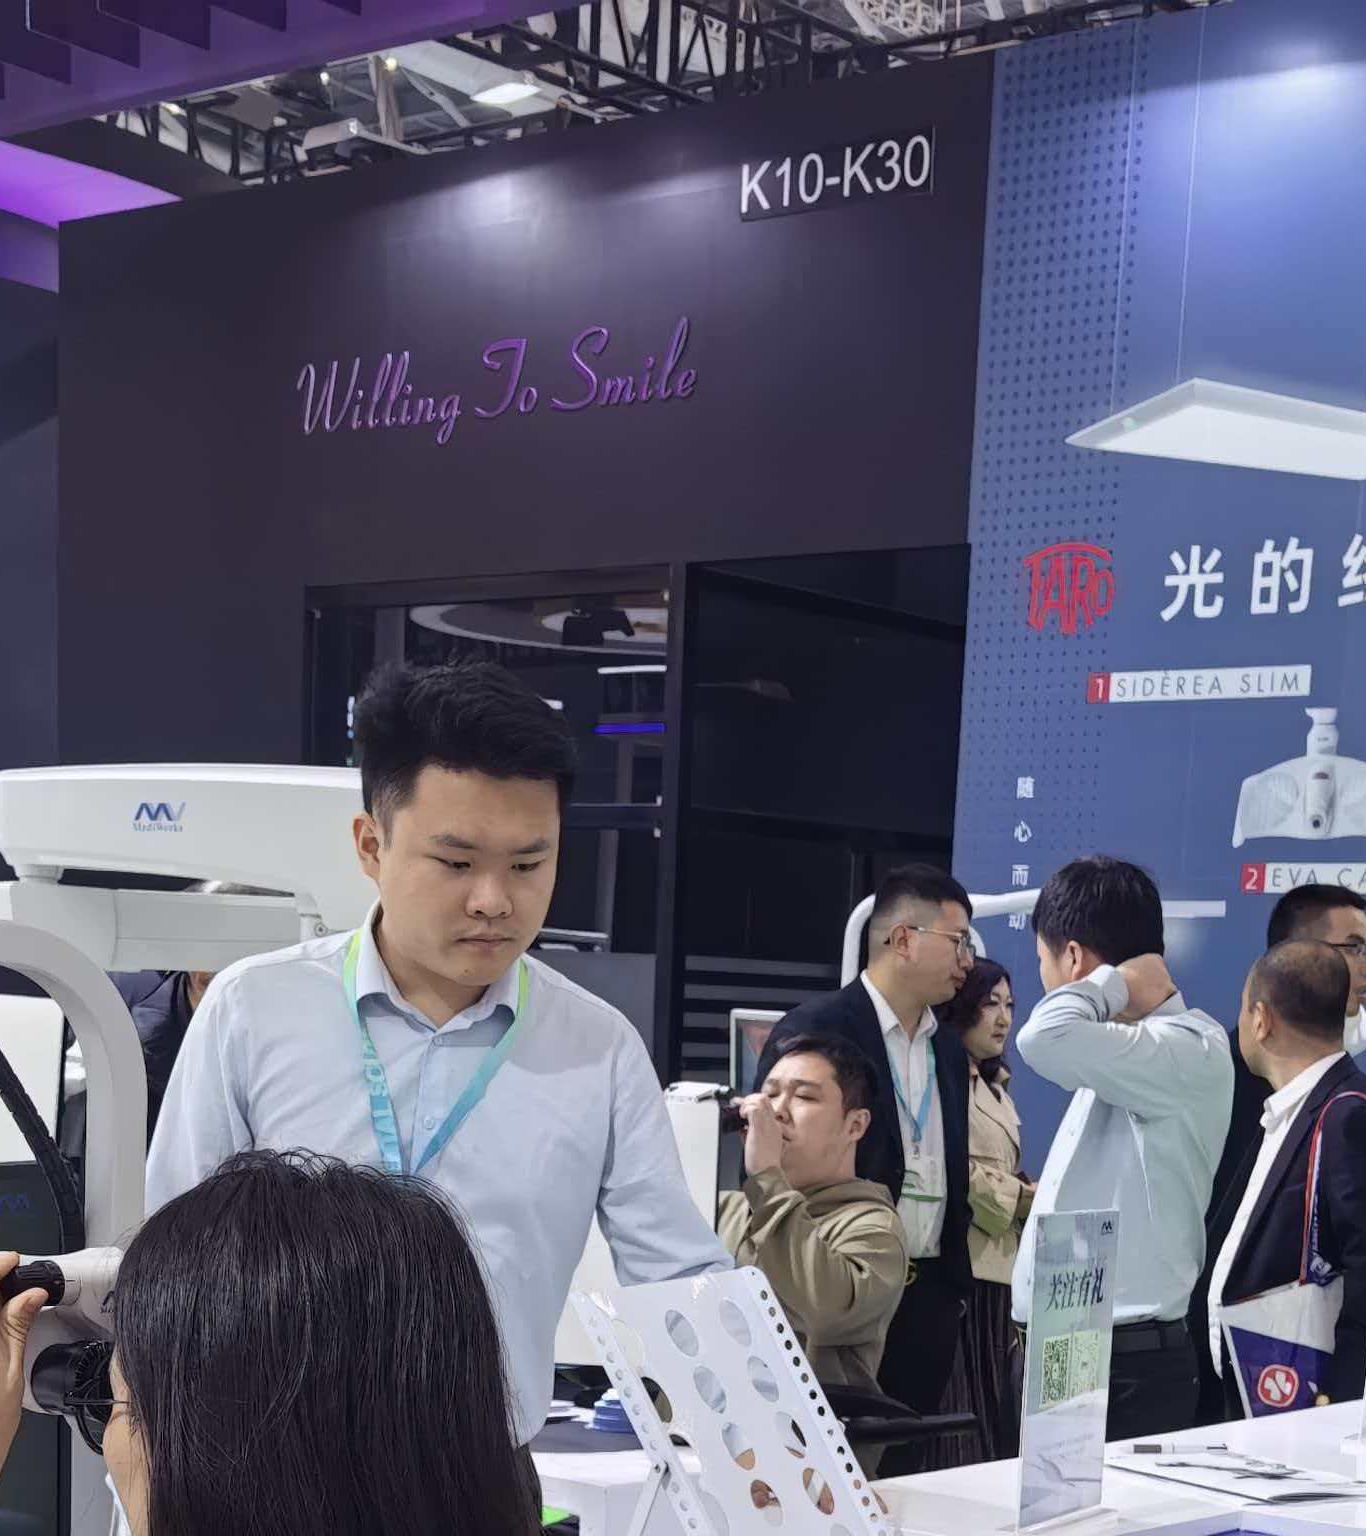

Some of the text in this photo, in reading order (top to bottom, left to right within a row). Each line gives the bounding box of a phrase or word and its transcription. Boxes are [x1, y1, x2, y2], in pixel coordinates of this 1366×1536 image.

[740, 134, 931, 214] K10-K30
[296, 315, 698, 445] Willing To Smile
[1239, 672, 1300, 694] SLIM
[1245, 868, 1259, 891] 2
[1044, 1266, 1105, 1313] 关注有礼
